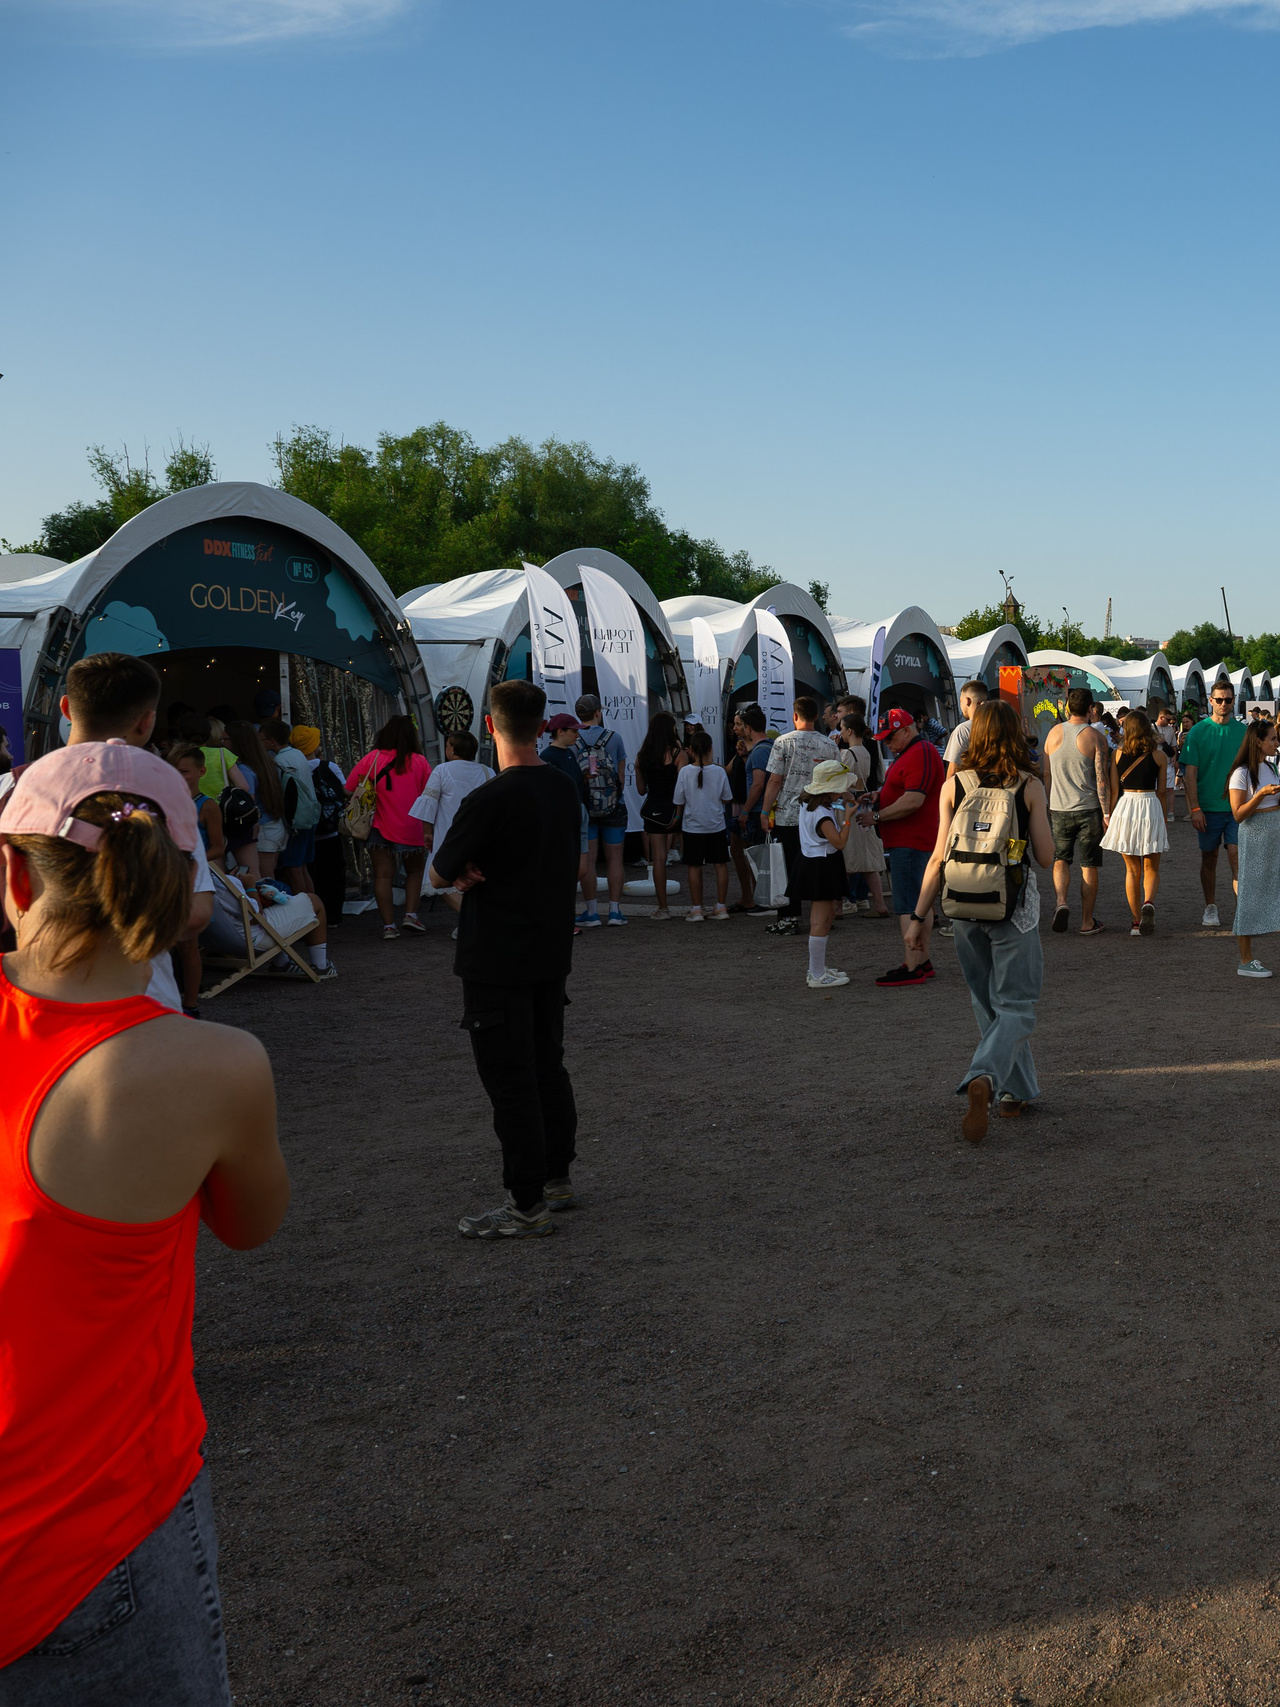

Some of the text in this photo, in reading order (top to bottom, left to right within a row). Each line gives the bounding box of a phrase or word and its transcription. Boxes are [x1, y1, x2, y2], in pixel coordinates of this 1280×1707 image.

[190, 583, 286, 614] GOLDEN
[274, 601, 305, 631] Key
[894, 654, 922, 668] ЭТИКА
